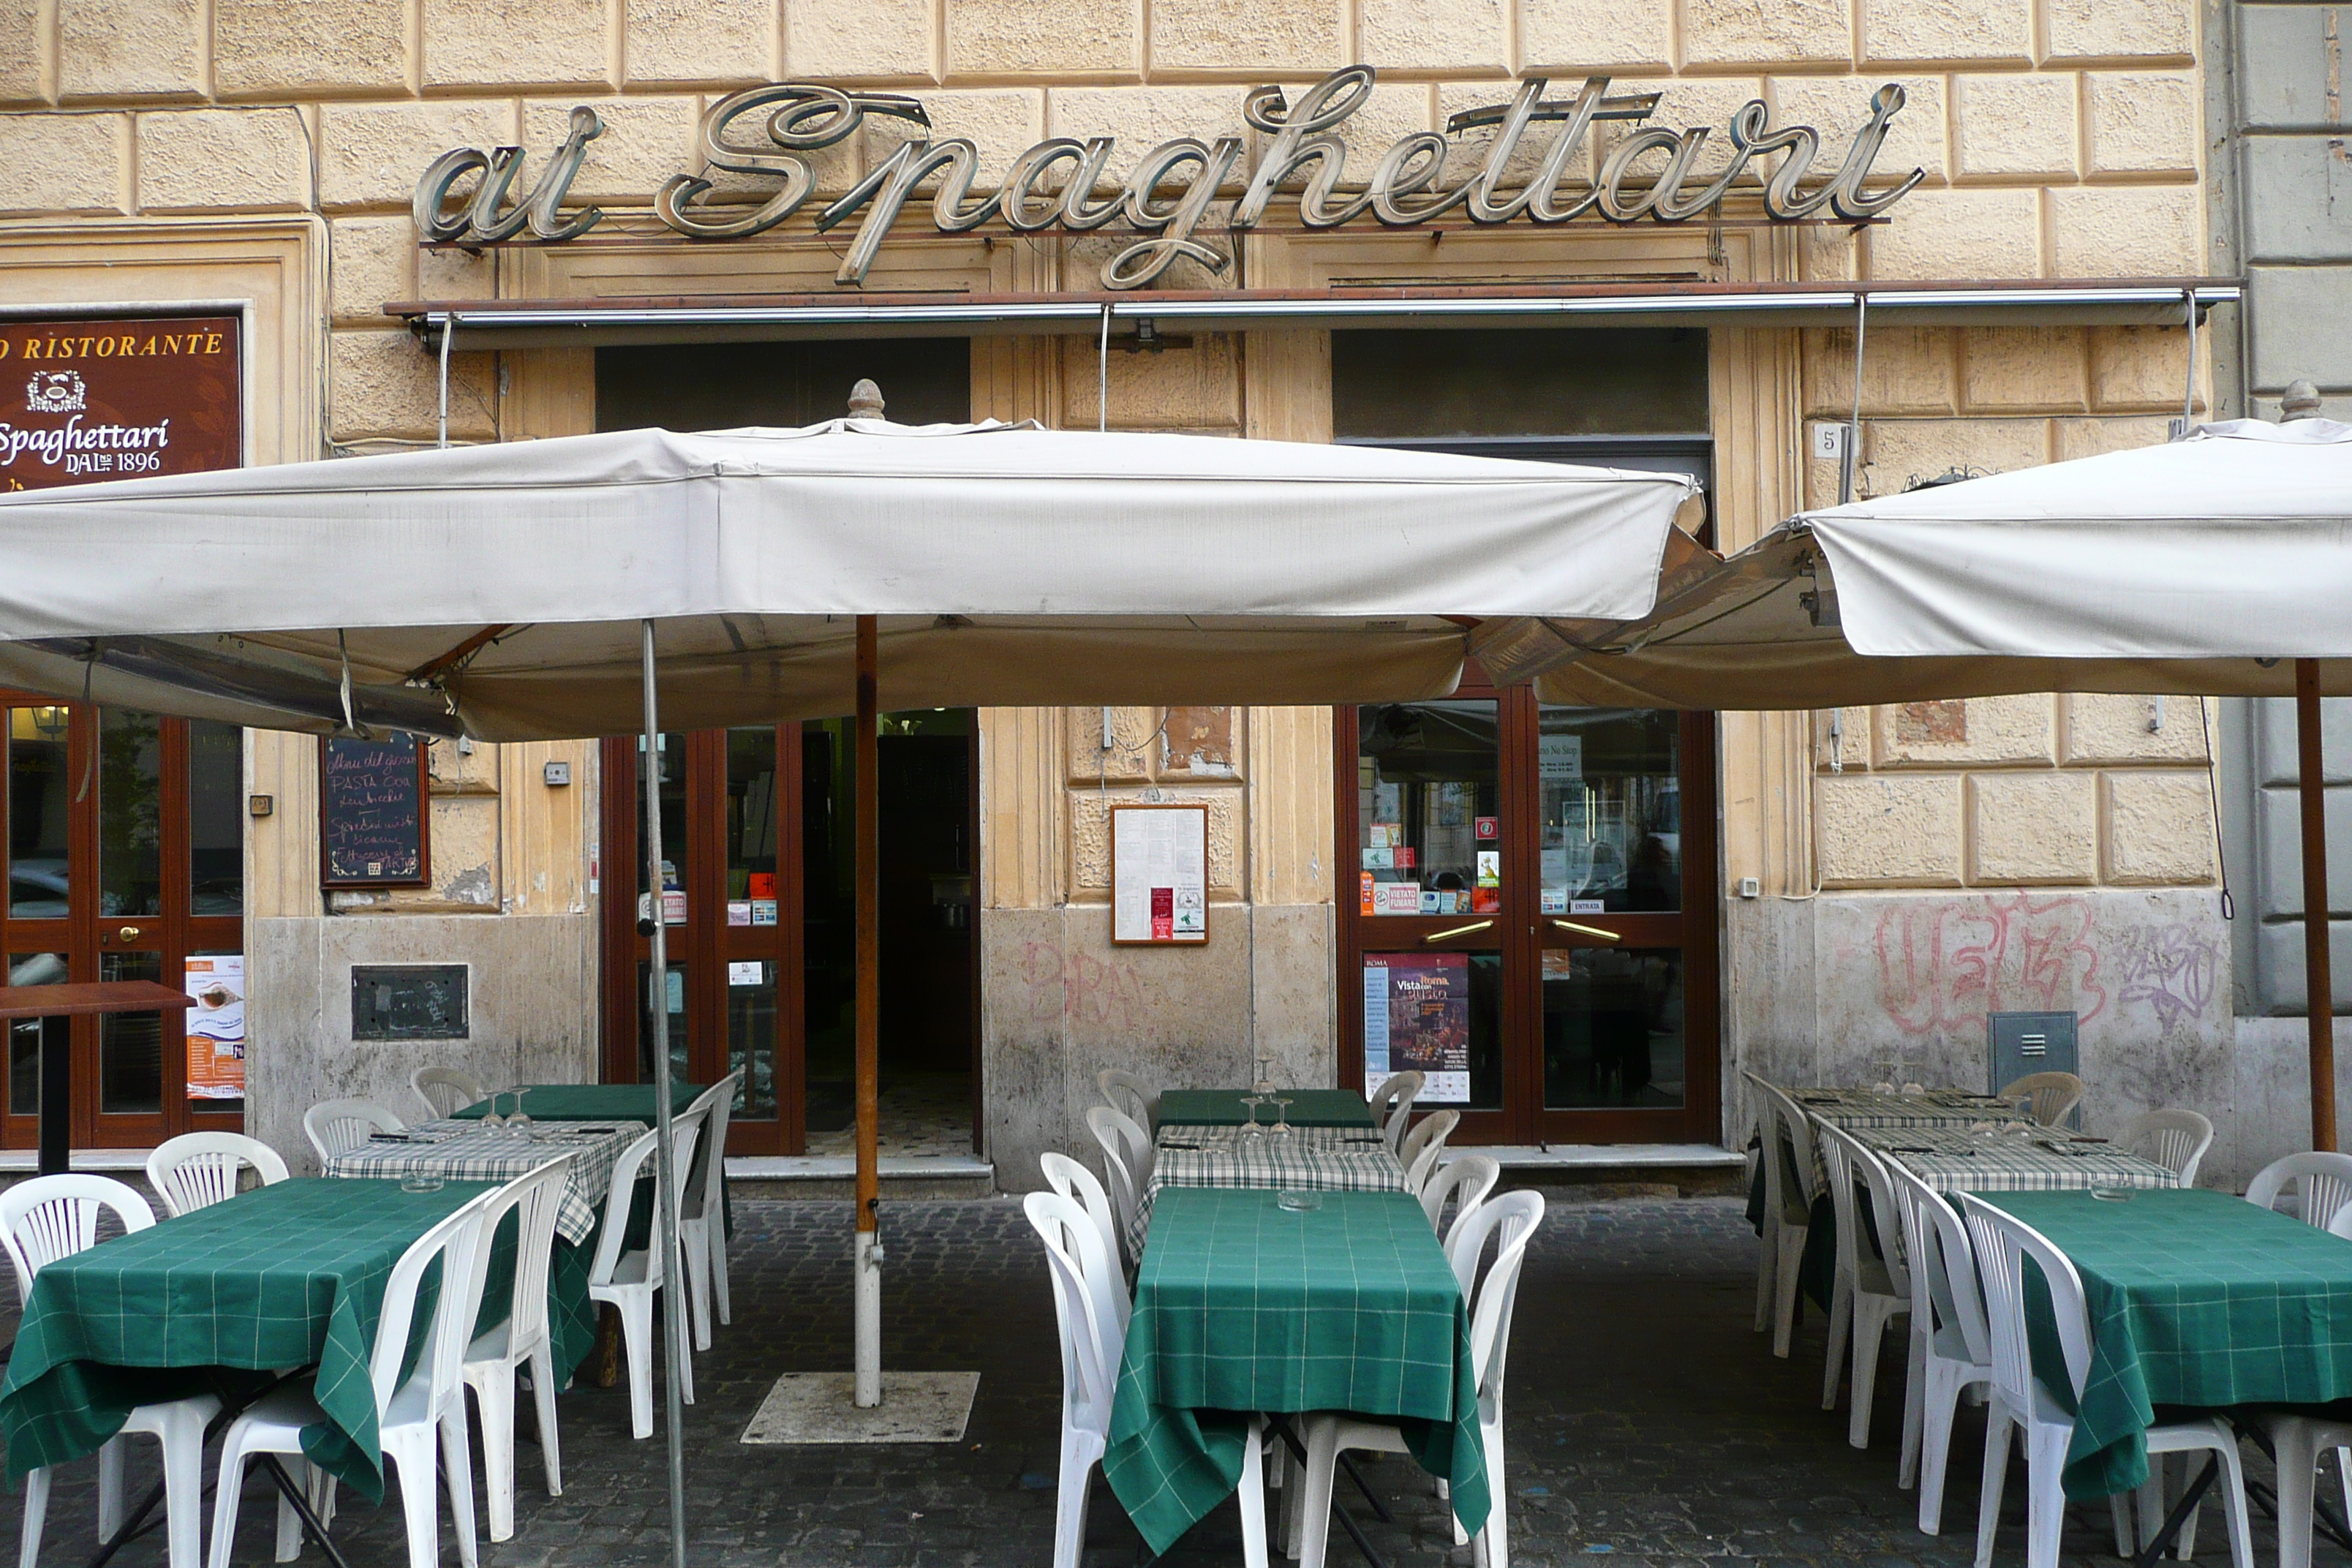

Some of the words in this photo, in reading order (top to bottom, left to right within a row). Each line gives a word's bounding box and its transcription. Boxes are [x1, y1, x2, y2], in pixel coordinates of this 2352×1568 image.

[412, 105, 603, 242] ai
[654, 64, 1926, 290] Spaghettari
[23, 333, 224, 359] RISTORANTE
[0, 414, 170, 466] Spaghettari
[1823, 431, 1835, 451] 5
[117, 451, 161, 472] 1896
[1550, 745, 1561, 755] No
[331, 773, 377, 794] PASTA
[1390, 890, 1416, 898] VIETATO
[663, 898, 684, 906] ETATO
[1390, 899, 1417, 907] FUMARE
[1575, 902, 1600, 911] ENTRATA
[1397, 979, 1421, 990] Vista
